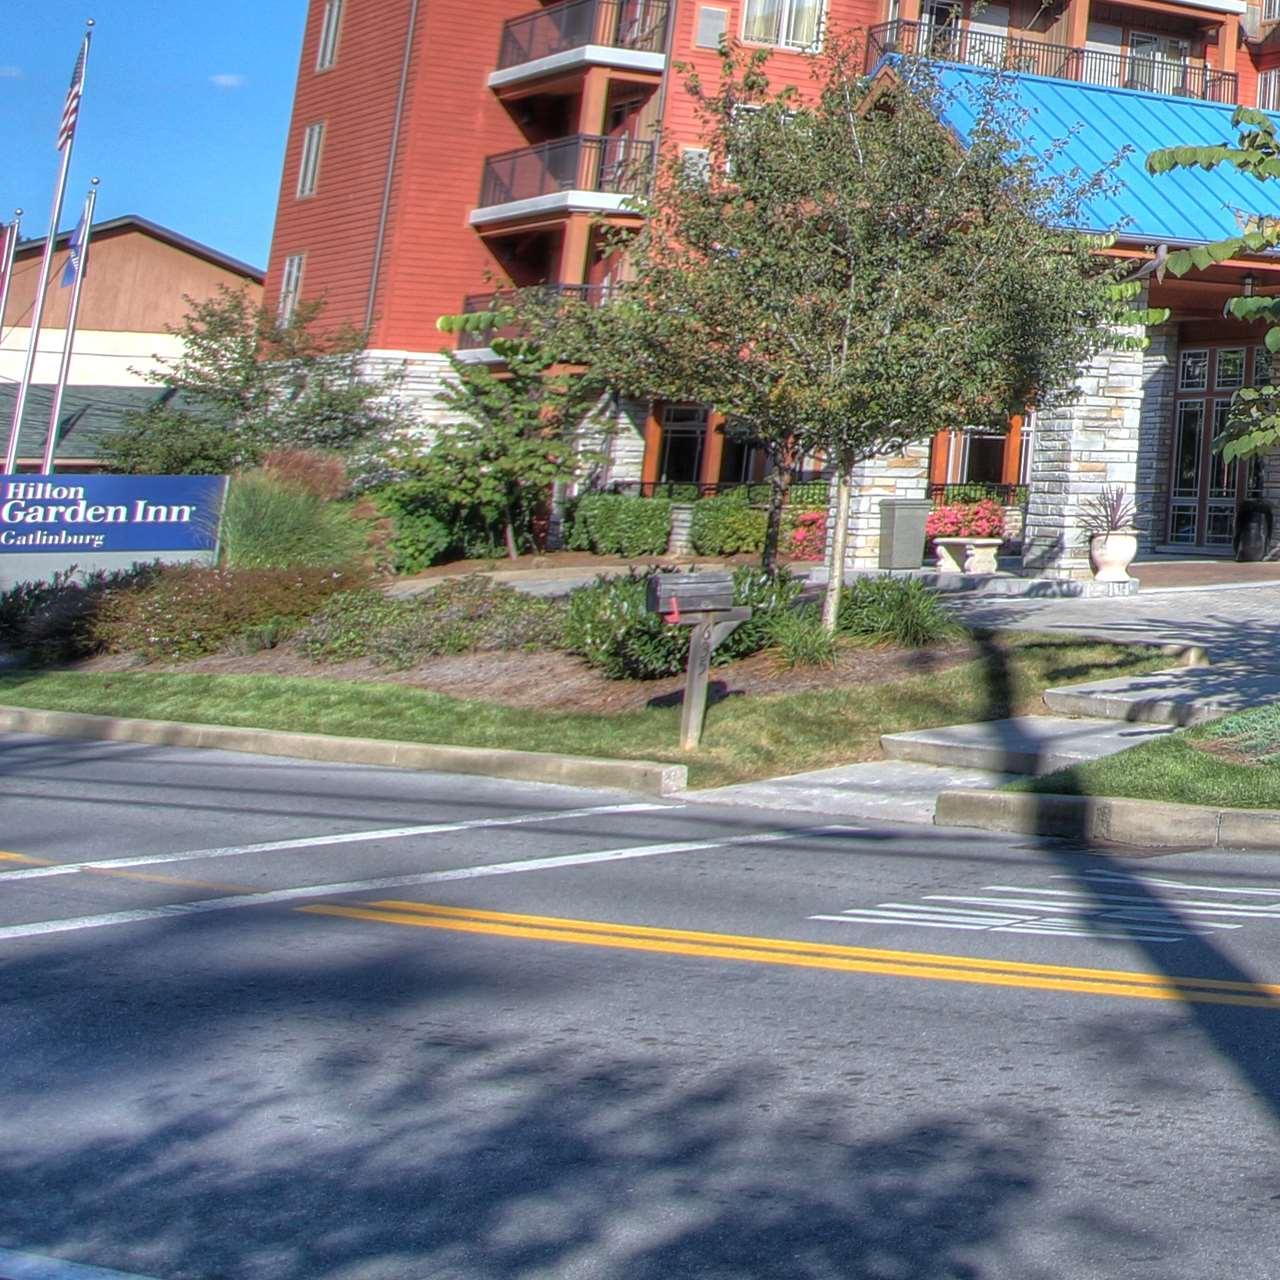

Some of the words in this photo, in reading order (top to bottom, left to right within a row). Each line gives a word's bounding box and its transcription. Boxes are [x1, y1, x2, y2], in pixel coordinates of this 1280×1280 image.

[7, 482, 85, 499] Hilton
[1, 500, 129, 524] Garden
[132, 500, 193, 524] Inn
[0, 530, 105, 548] Gatlinburg
